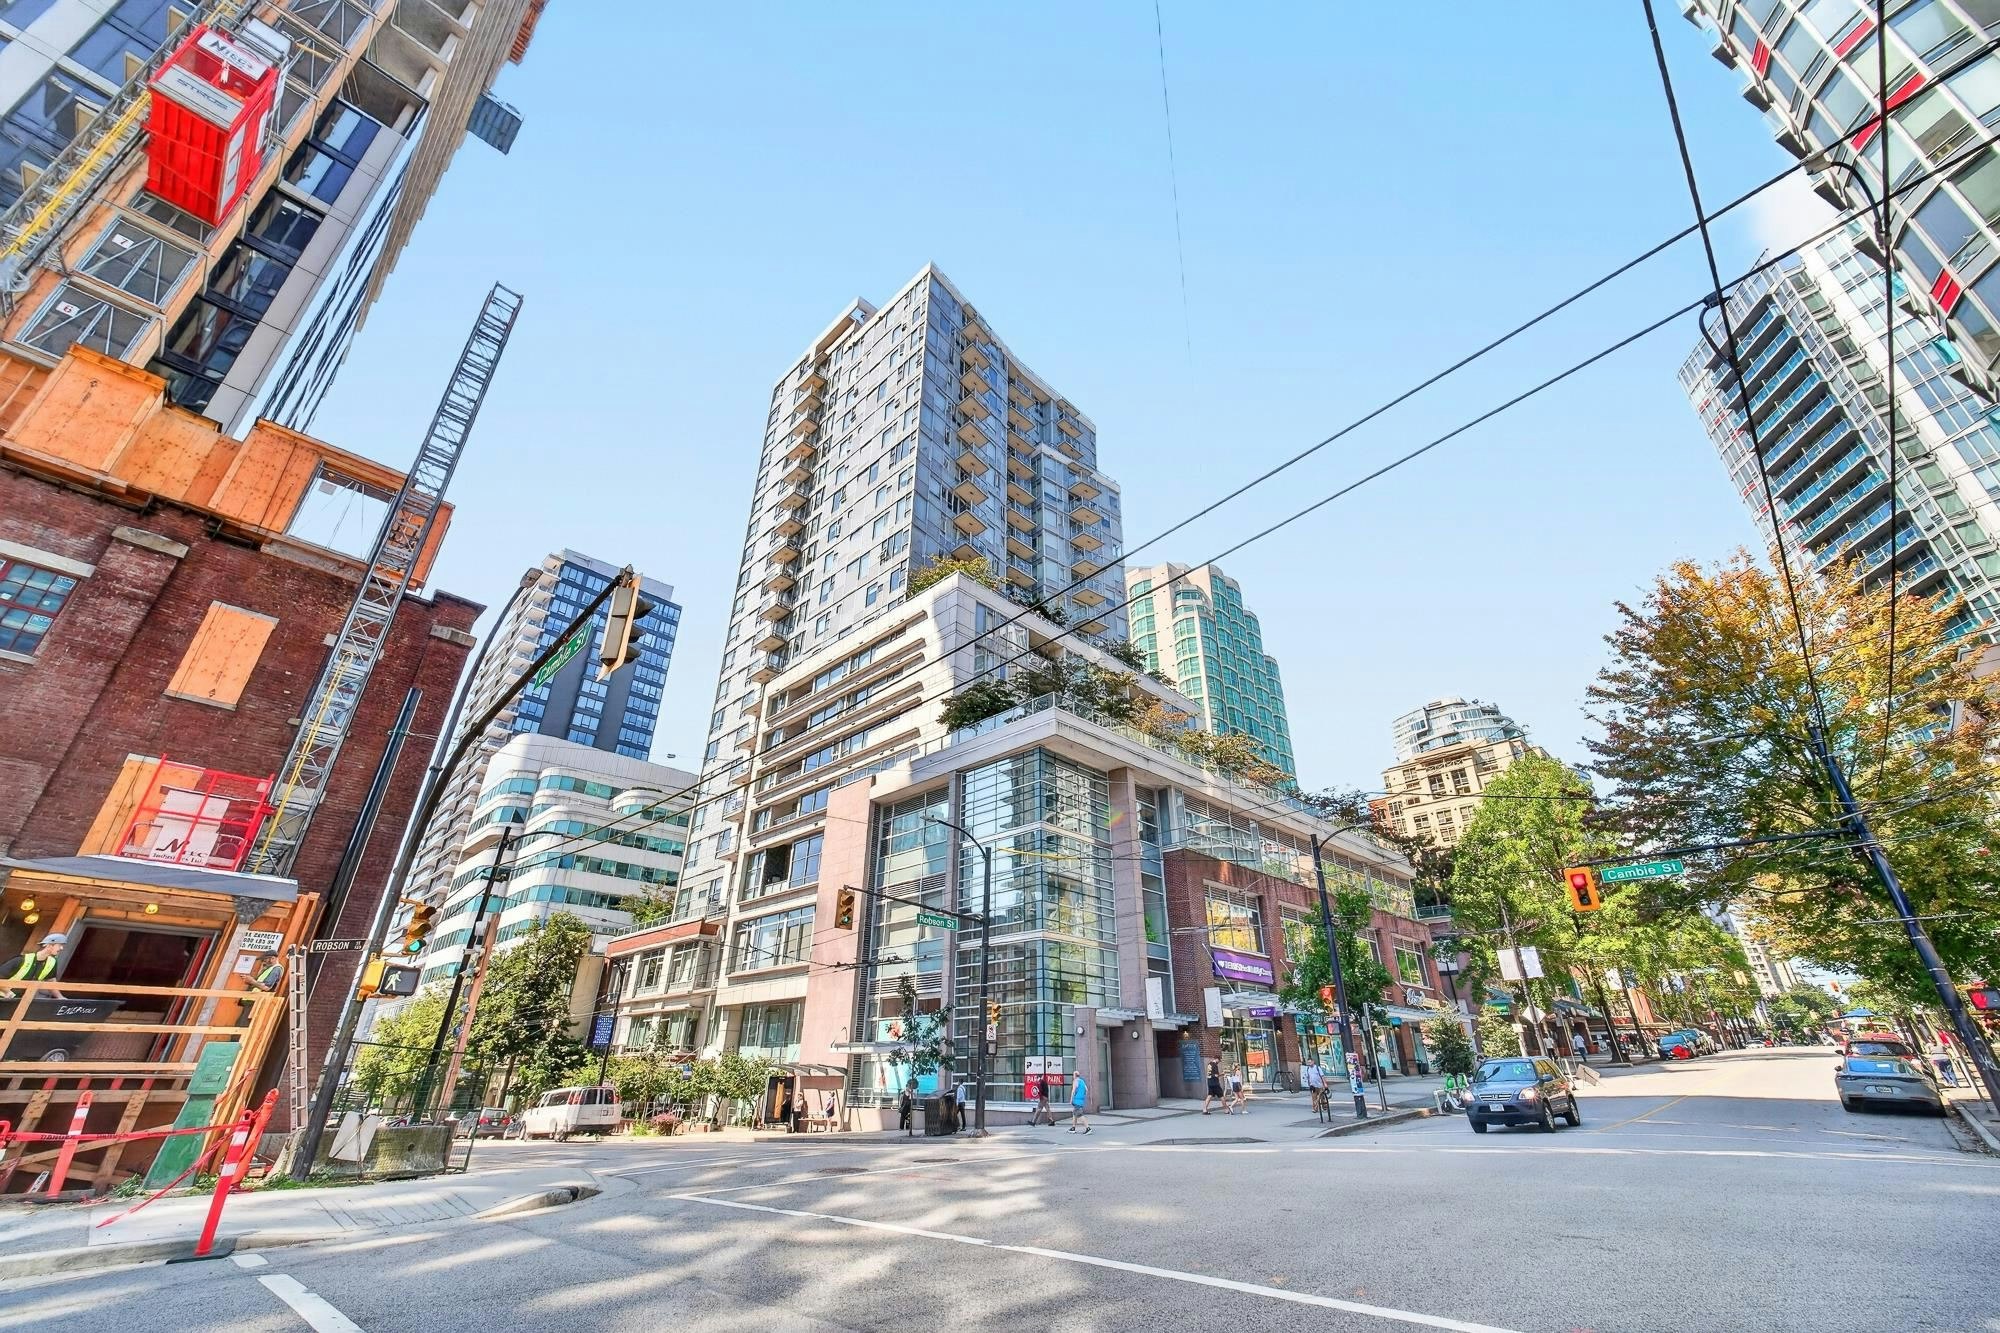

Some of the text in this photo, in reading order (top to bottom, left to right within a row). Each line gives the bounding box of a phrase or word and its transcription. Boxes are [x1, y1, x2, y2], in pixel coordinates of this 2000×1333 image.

[63, 304, 73, 313] 6
[1607, 862, 1678, 880] Cambie St
[919, 916, 955, 928] Robson St
[315, 941, 350, 950] ROBSON
